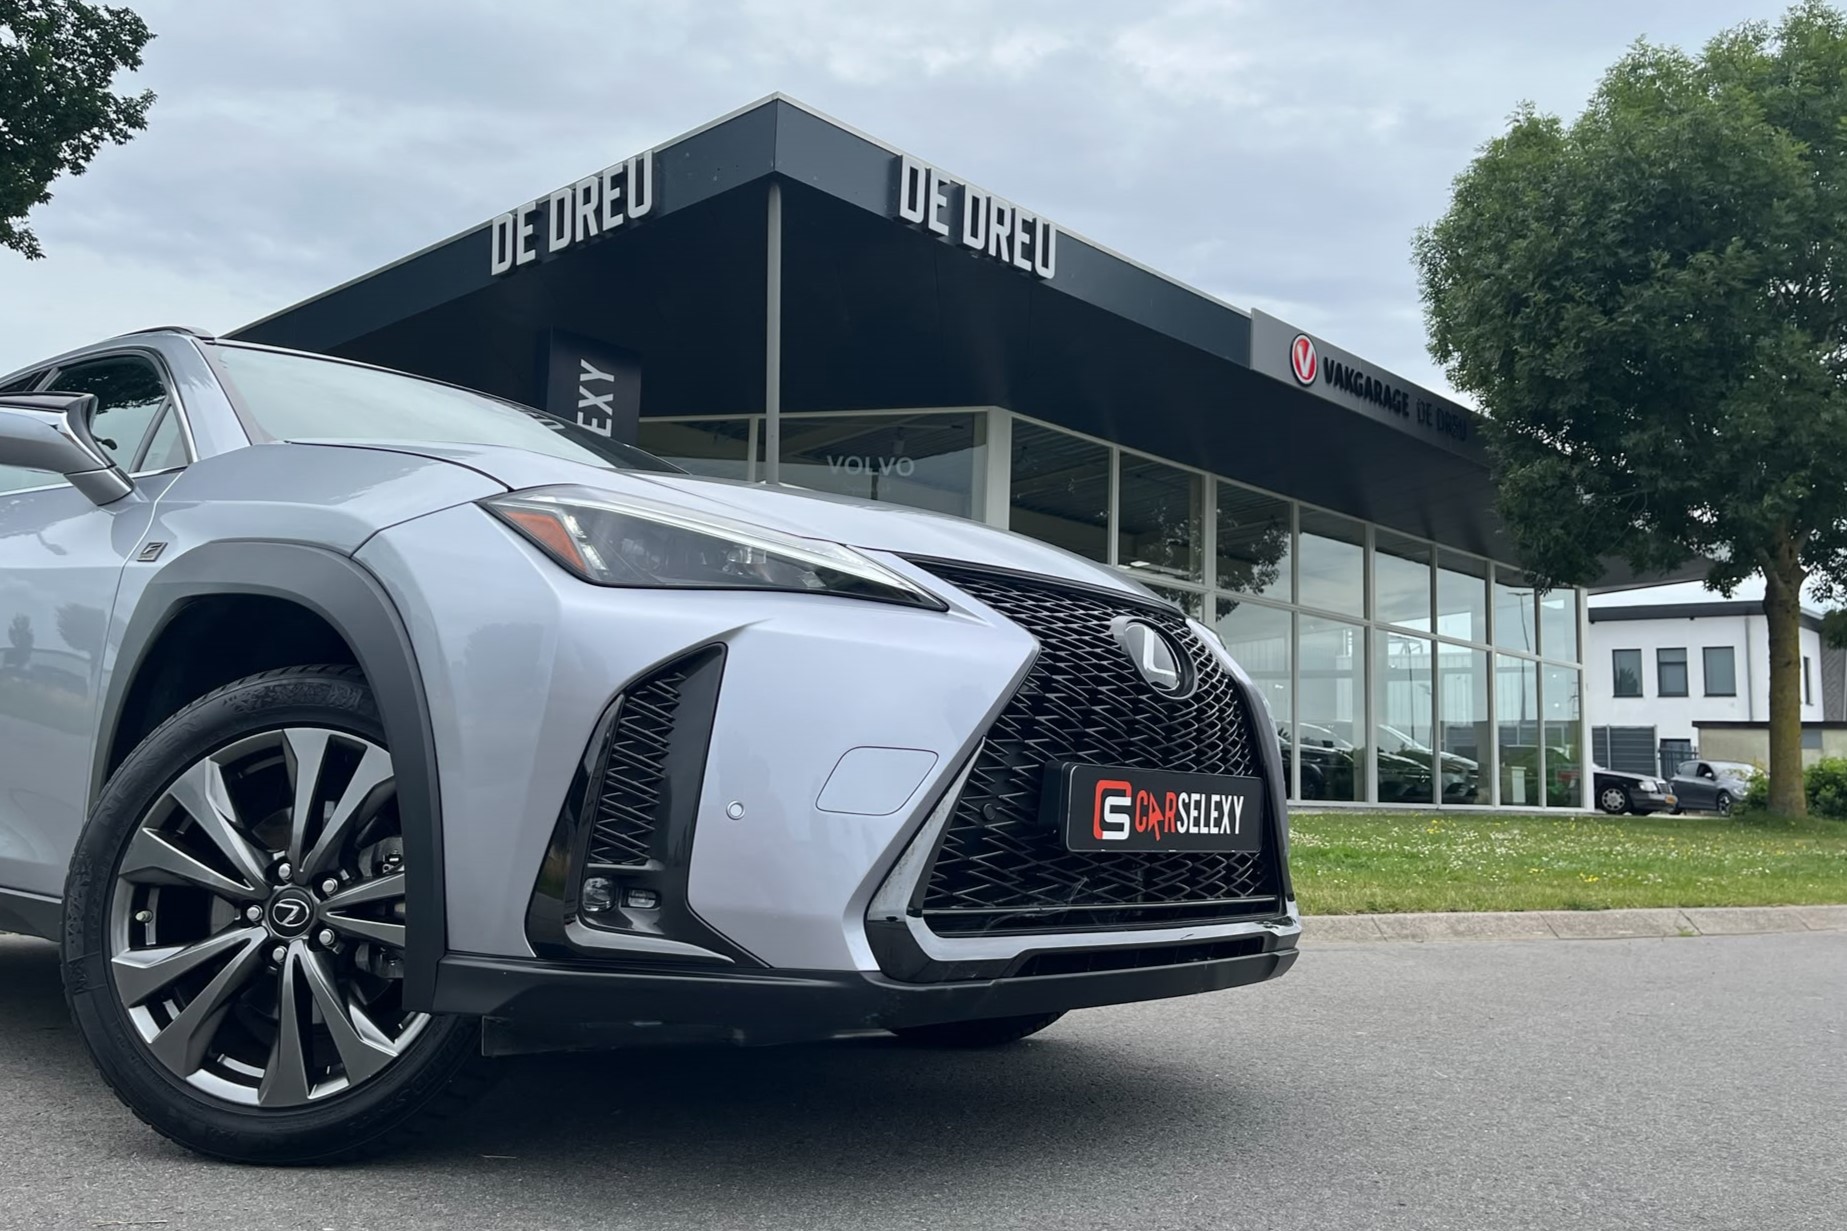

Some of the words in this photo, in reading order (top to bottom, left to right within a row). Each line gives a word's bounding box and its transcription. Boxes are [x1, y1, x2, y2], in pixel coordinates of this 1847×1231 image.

[491, 200, 536, 276] DE
[549, 150, 653, 253] DREU
[899, 155, 950, 237] DE
[962, 185, 1057, 280] DREU
[1323, 356, 1410, 419] VAKGARAGE
[1416, 399, 1432, 426] DE
[1436, 408, 1467, 442] DREU
[826, 455, 915, 477] VOLVO
[1134, 789, 1245, 842] CARSELEXY
